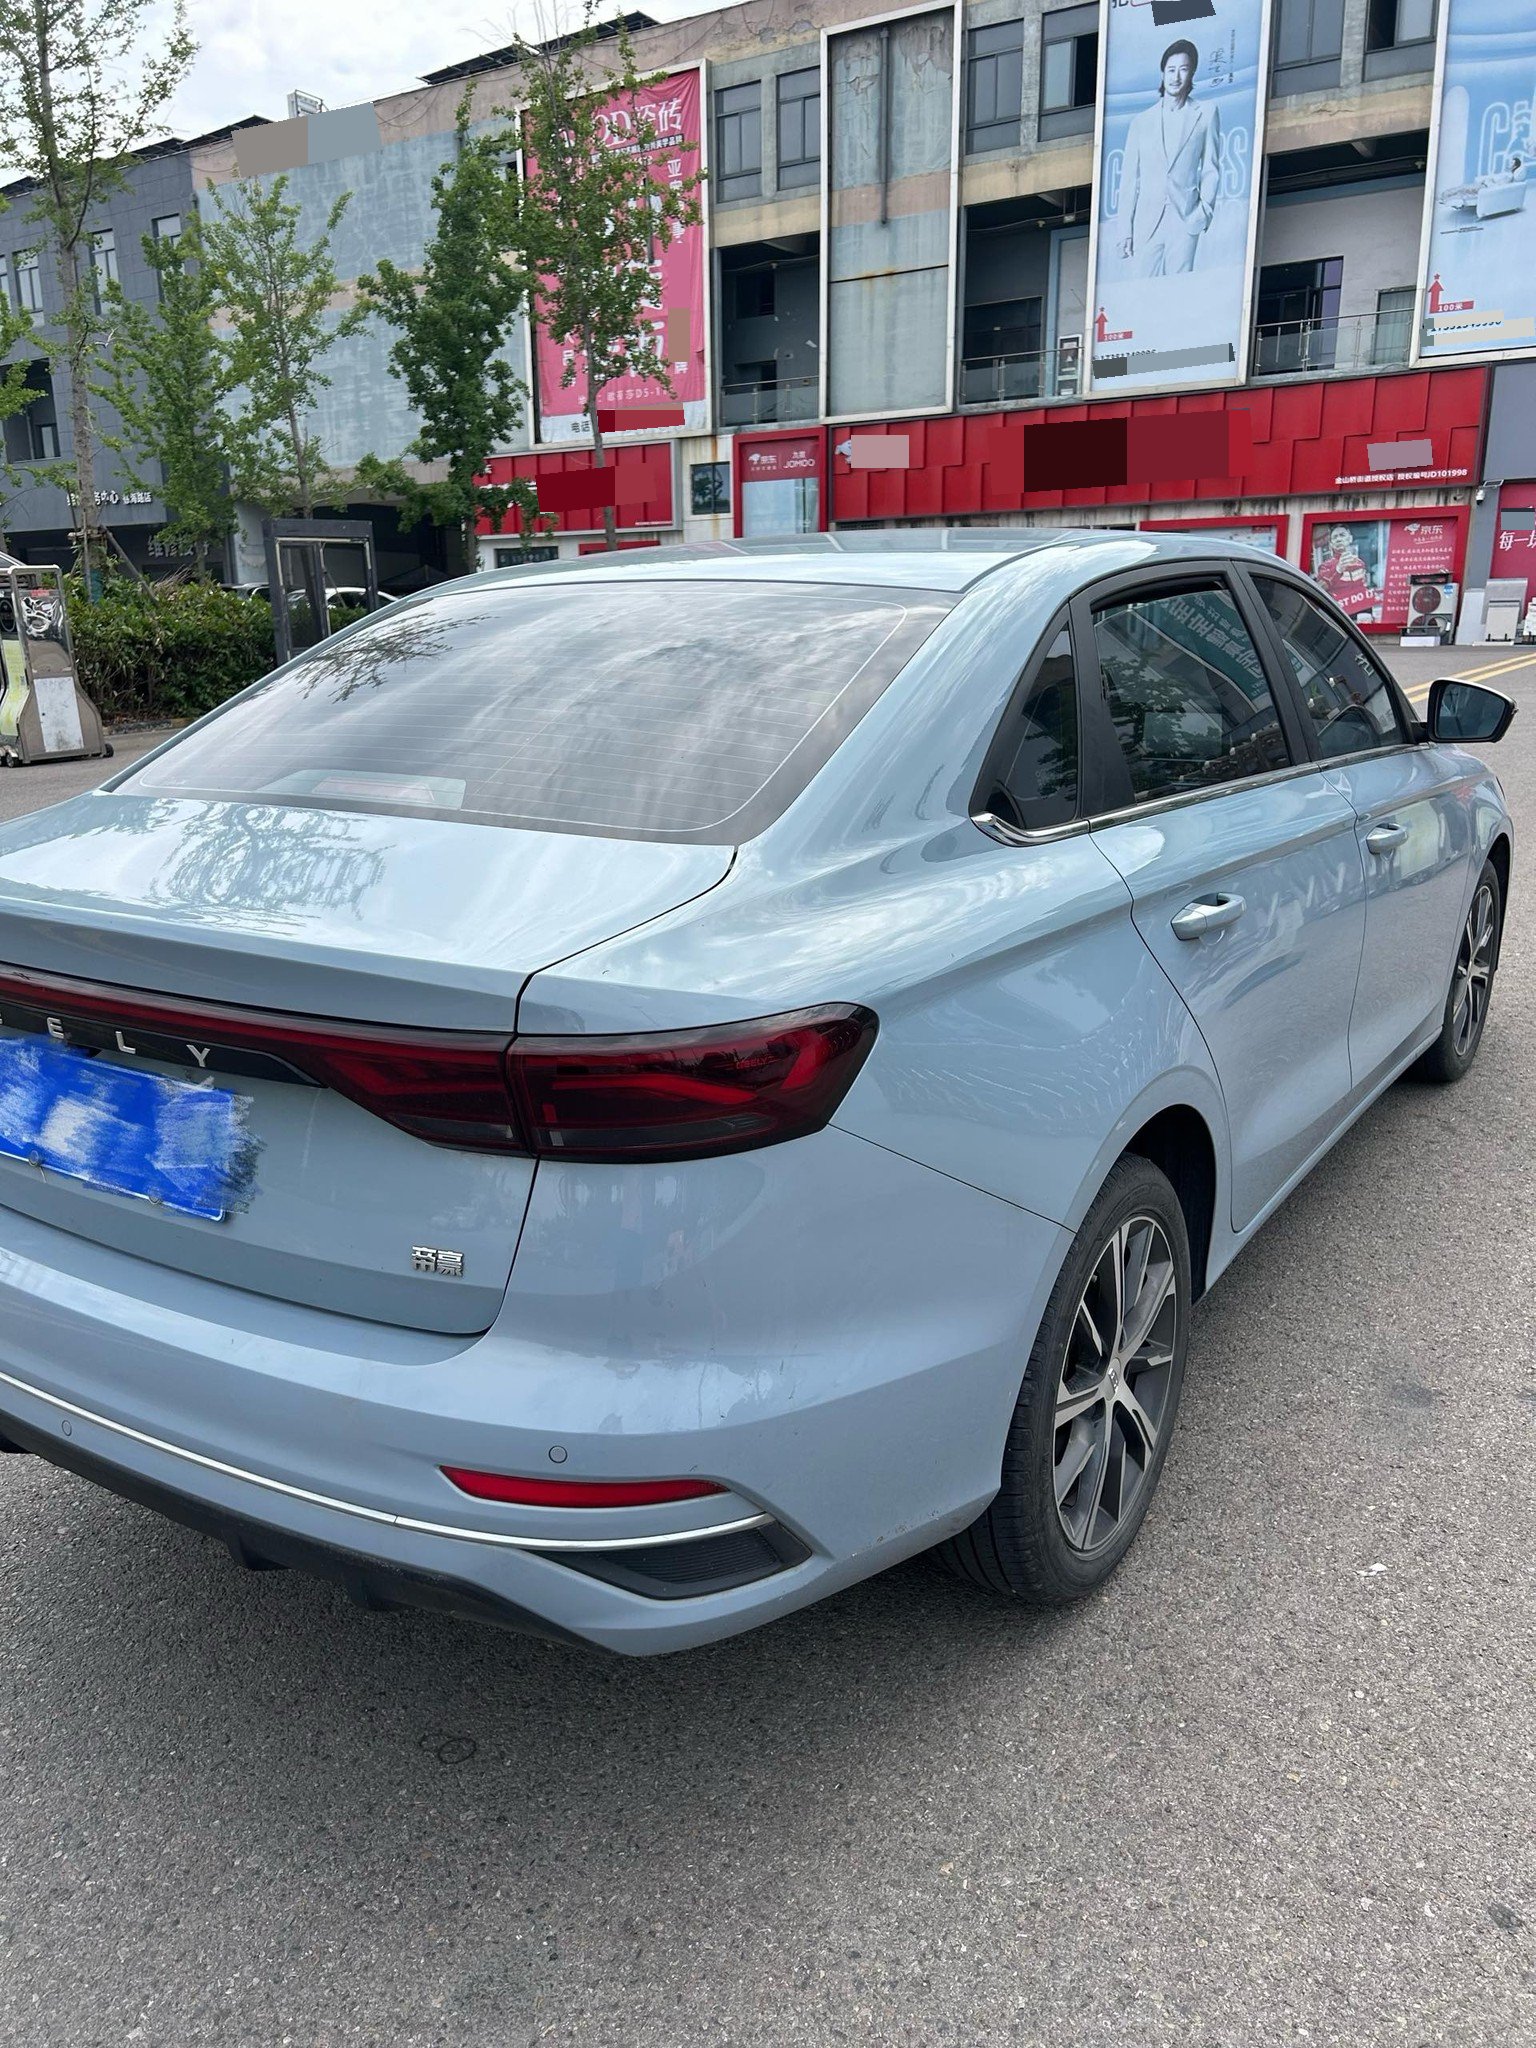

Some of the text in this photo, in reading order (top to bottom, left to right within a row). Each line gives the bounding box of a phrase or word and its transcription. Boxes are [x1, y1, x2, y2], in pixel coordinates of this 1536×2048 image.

[783, 459, 815, 469] JOMOO
[1420, 524, 1443, 534] 京东
[1351, 592, 1364, 604] DO
[0, 1013, 211, 1068] ELY
[411, 1245, 464, 1277] 帝豪
